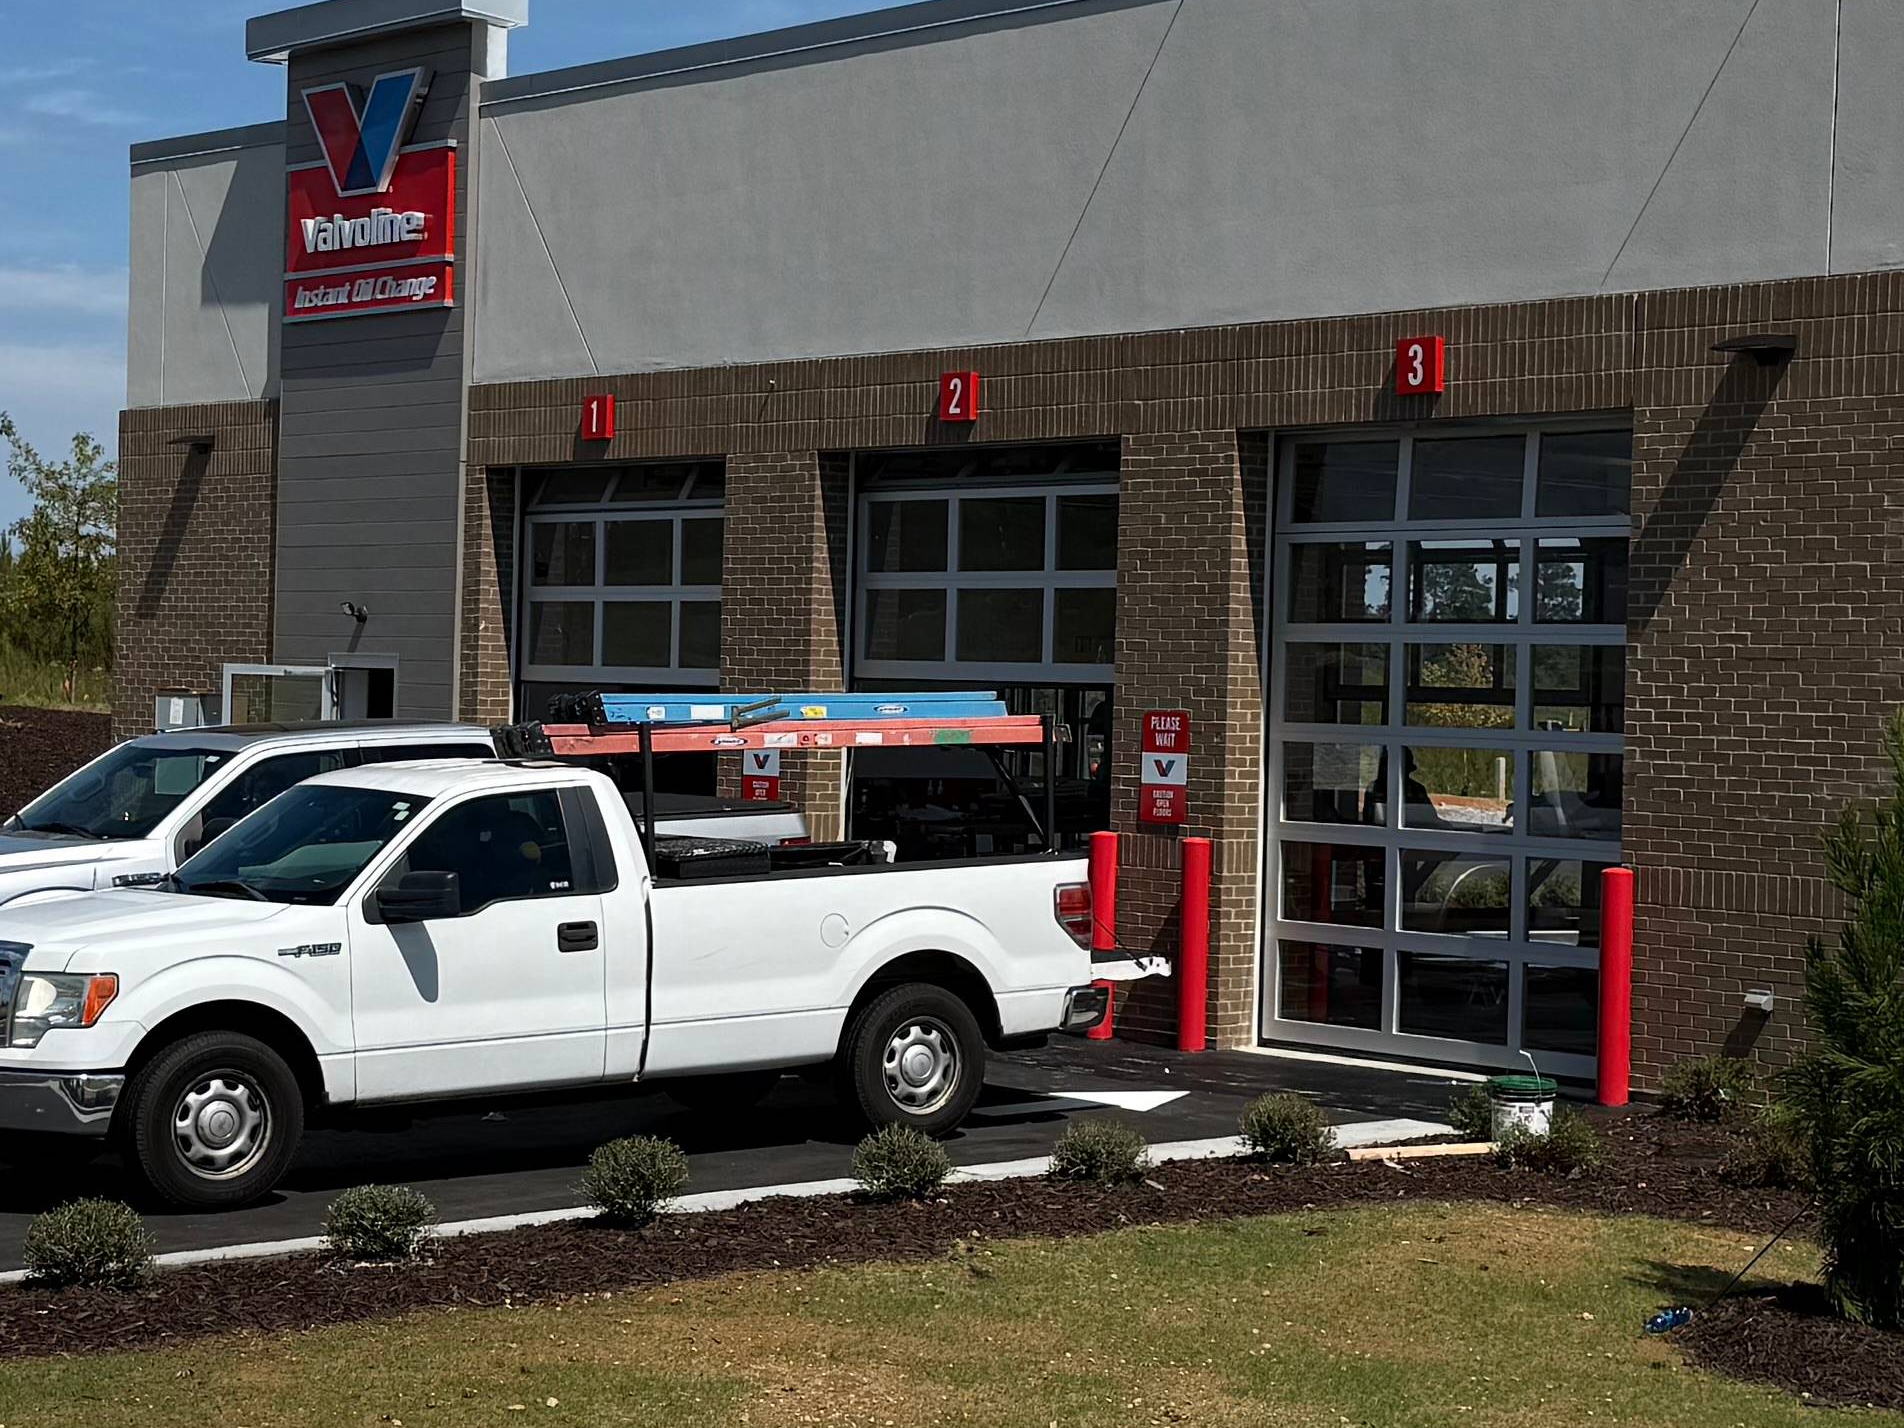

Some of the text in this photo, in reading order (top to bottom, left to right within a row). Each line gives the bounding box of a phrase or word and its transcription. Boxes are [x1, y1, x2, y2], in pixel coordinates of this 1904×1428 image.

[300, 207, 426, 254] Valvoline
[294, 275, 438, 309] Instant Oil Change
[1407, 343, 1424, 386] 3
[948, 377, 962, 414] 2
[590, 400, 598, 433] 1
[1151, 716, 1182, 731] PLEASE
[1155, 732, 1176, 748] WAIT
